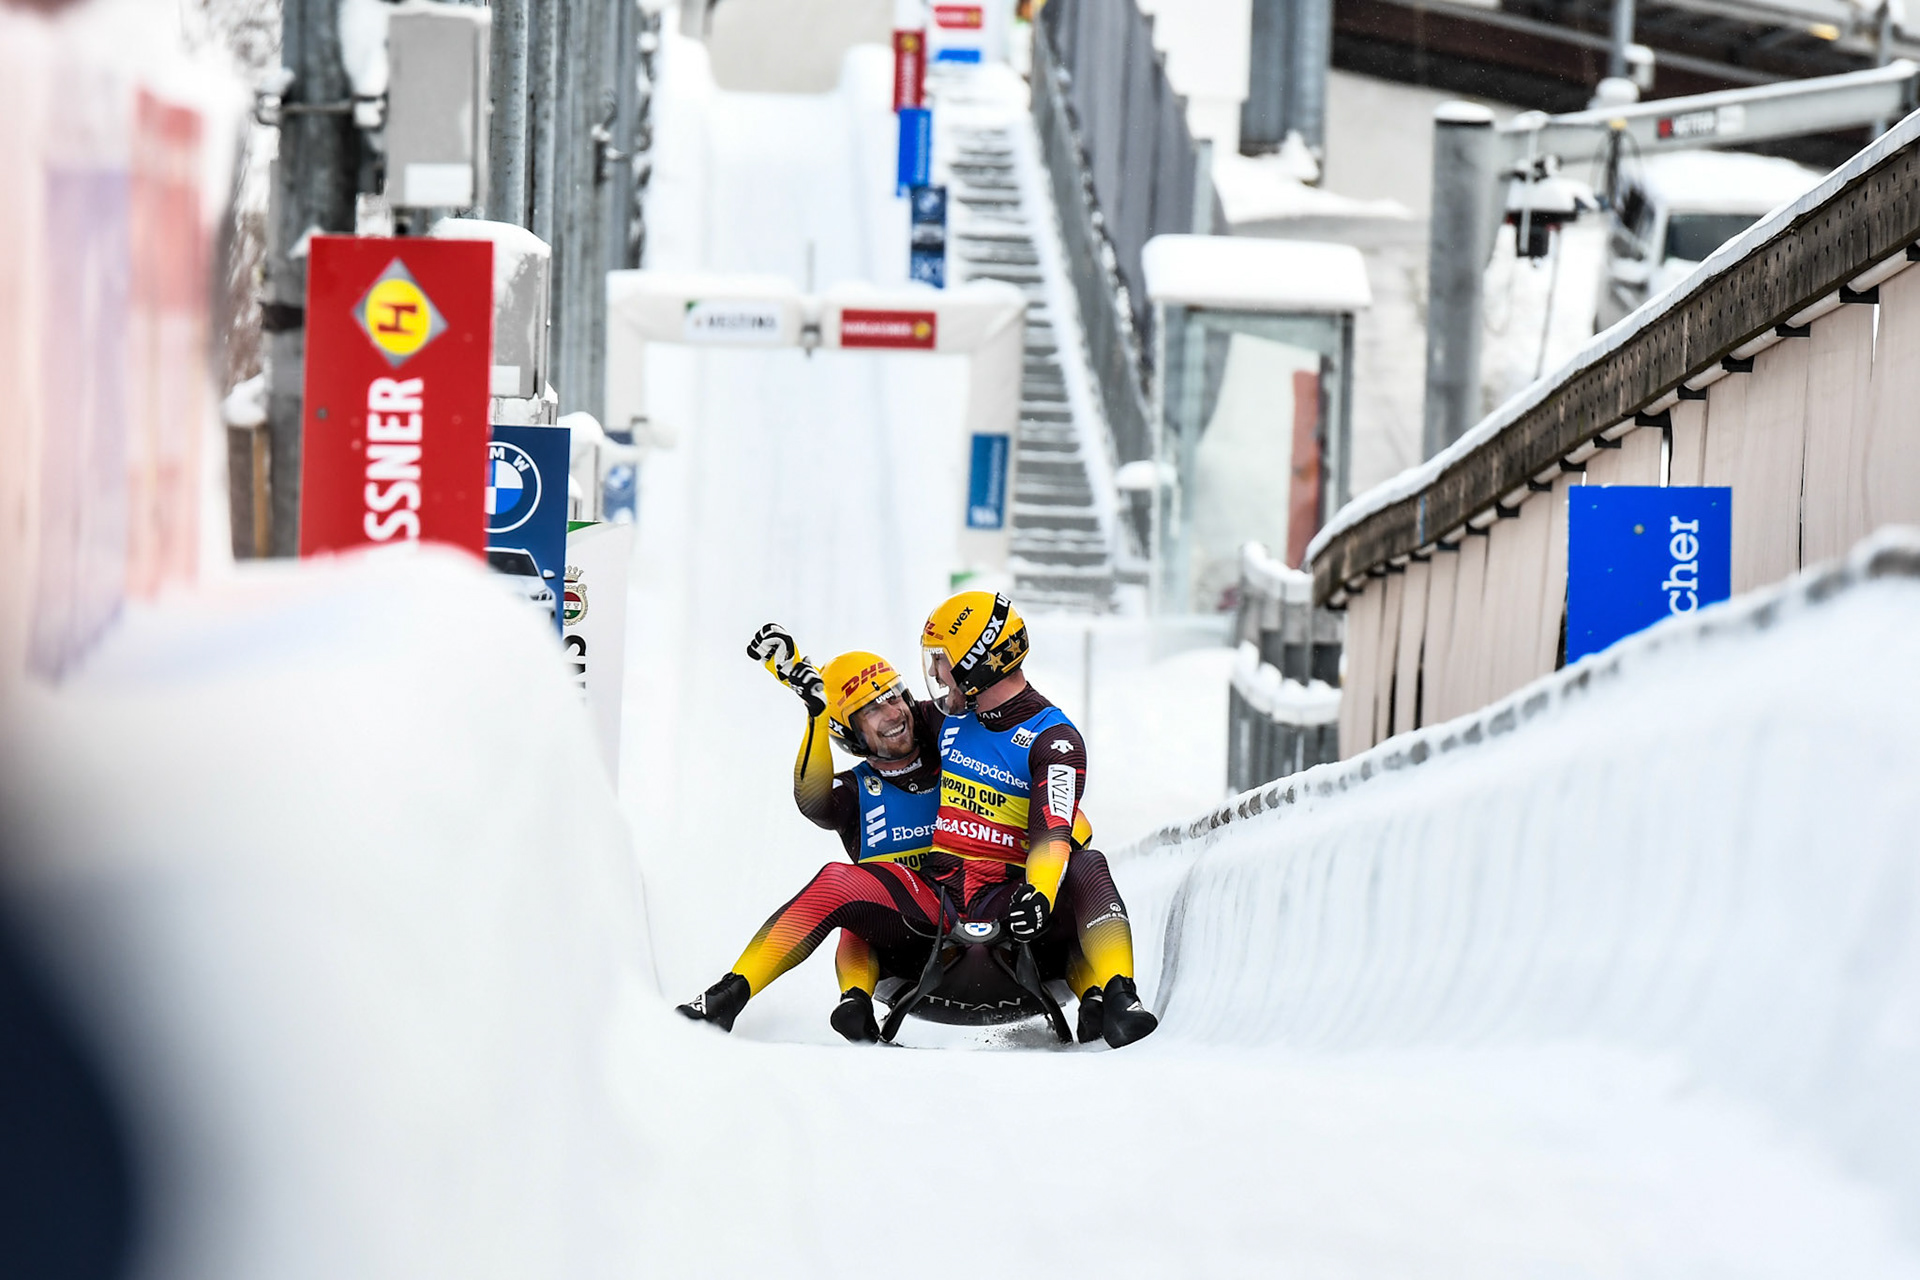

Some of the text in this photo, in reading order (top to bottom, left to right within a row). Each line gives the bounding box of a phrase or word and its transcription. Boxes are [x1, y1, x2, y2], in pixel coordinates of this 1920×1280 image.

[364, 376, 424, 547] SSNER
[1662, 515, 1699, 615] cher
[948, 606, 974, 635] uvex
[960, 615, 1004, 670] uvex
[841, 661, 892, 698] DHL
[875, 689, 895, 704] uvex
[949, 749, 1030, 790] Eberspächer
[942, 776, 1007, 808] WORLD CUP
[1052, 769, 1069, 815] TITAN
[924, 994, 1020, 1011] TITAN
